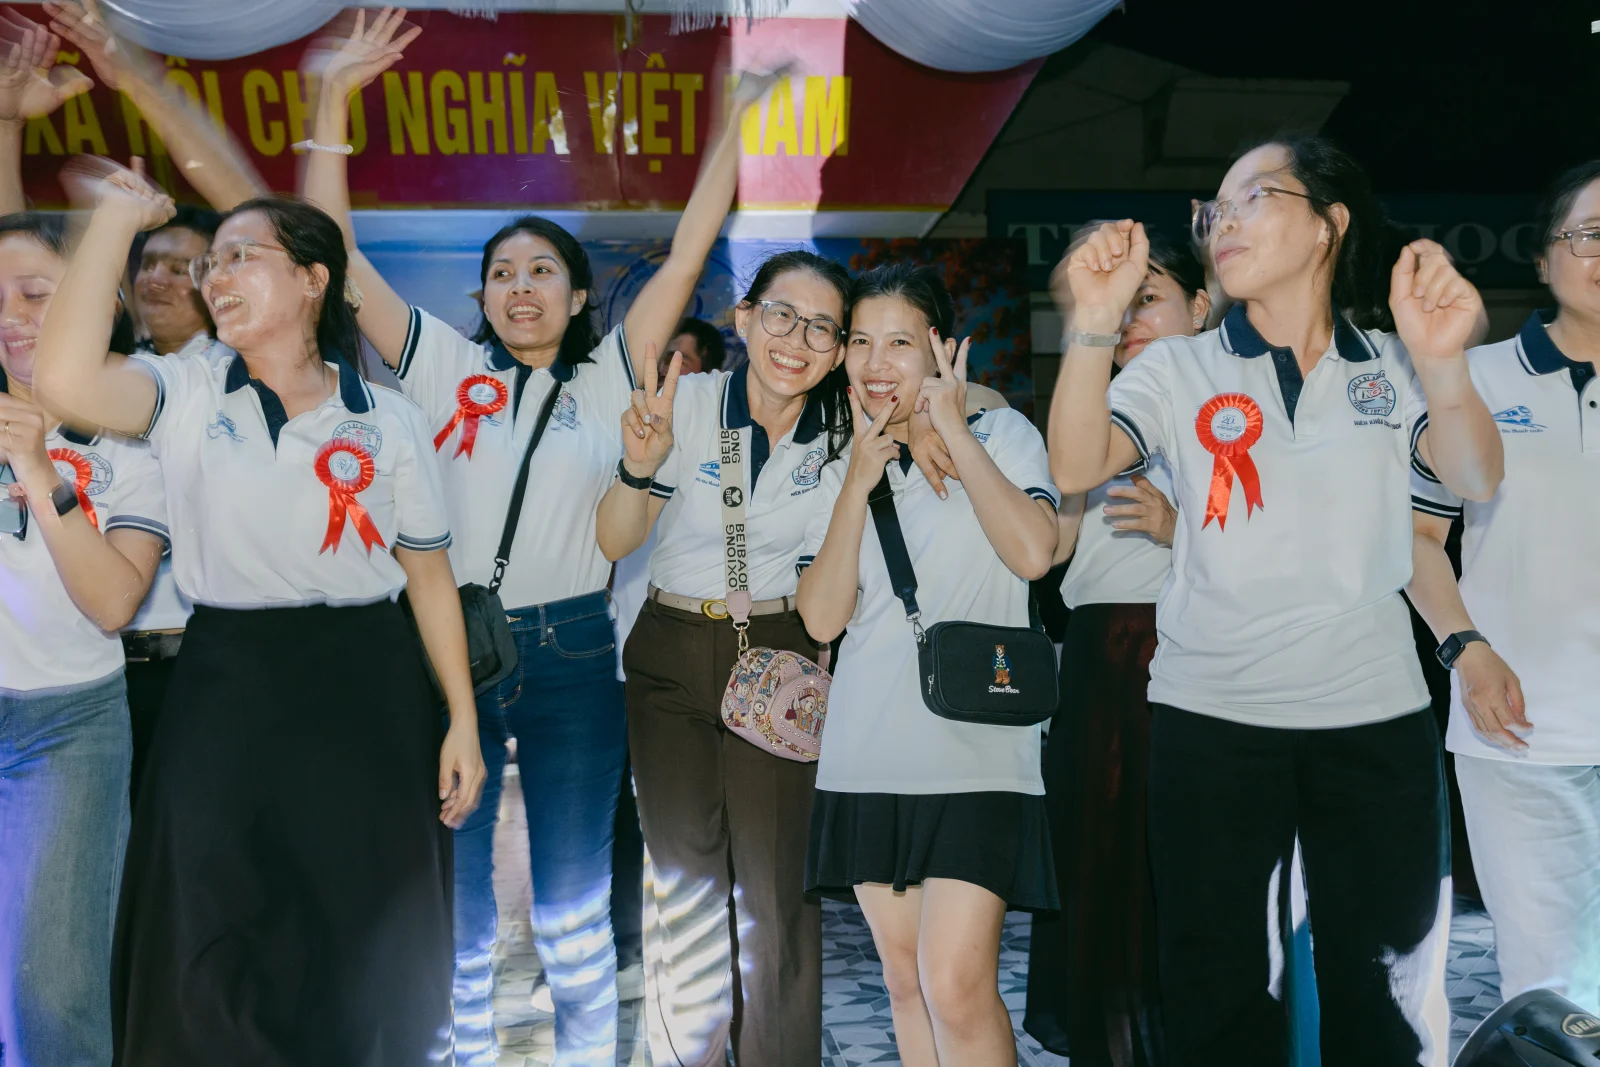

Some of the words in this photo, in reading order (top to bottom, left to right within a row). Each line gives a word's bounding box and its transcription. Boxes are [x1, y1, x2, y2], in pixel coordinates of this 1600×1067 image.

[383, 52, 570, 156] NGHĨA
[585, 52, 704, 173] VIỆT
[725, 524, 738, 591] OXIONG
